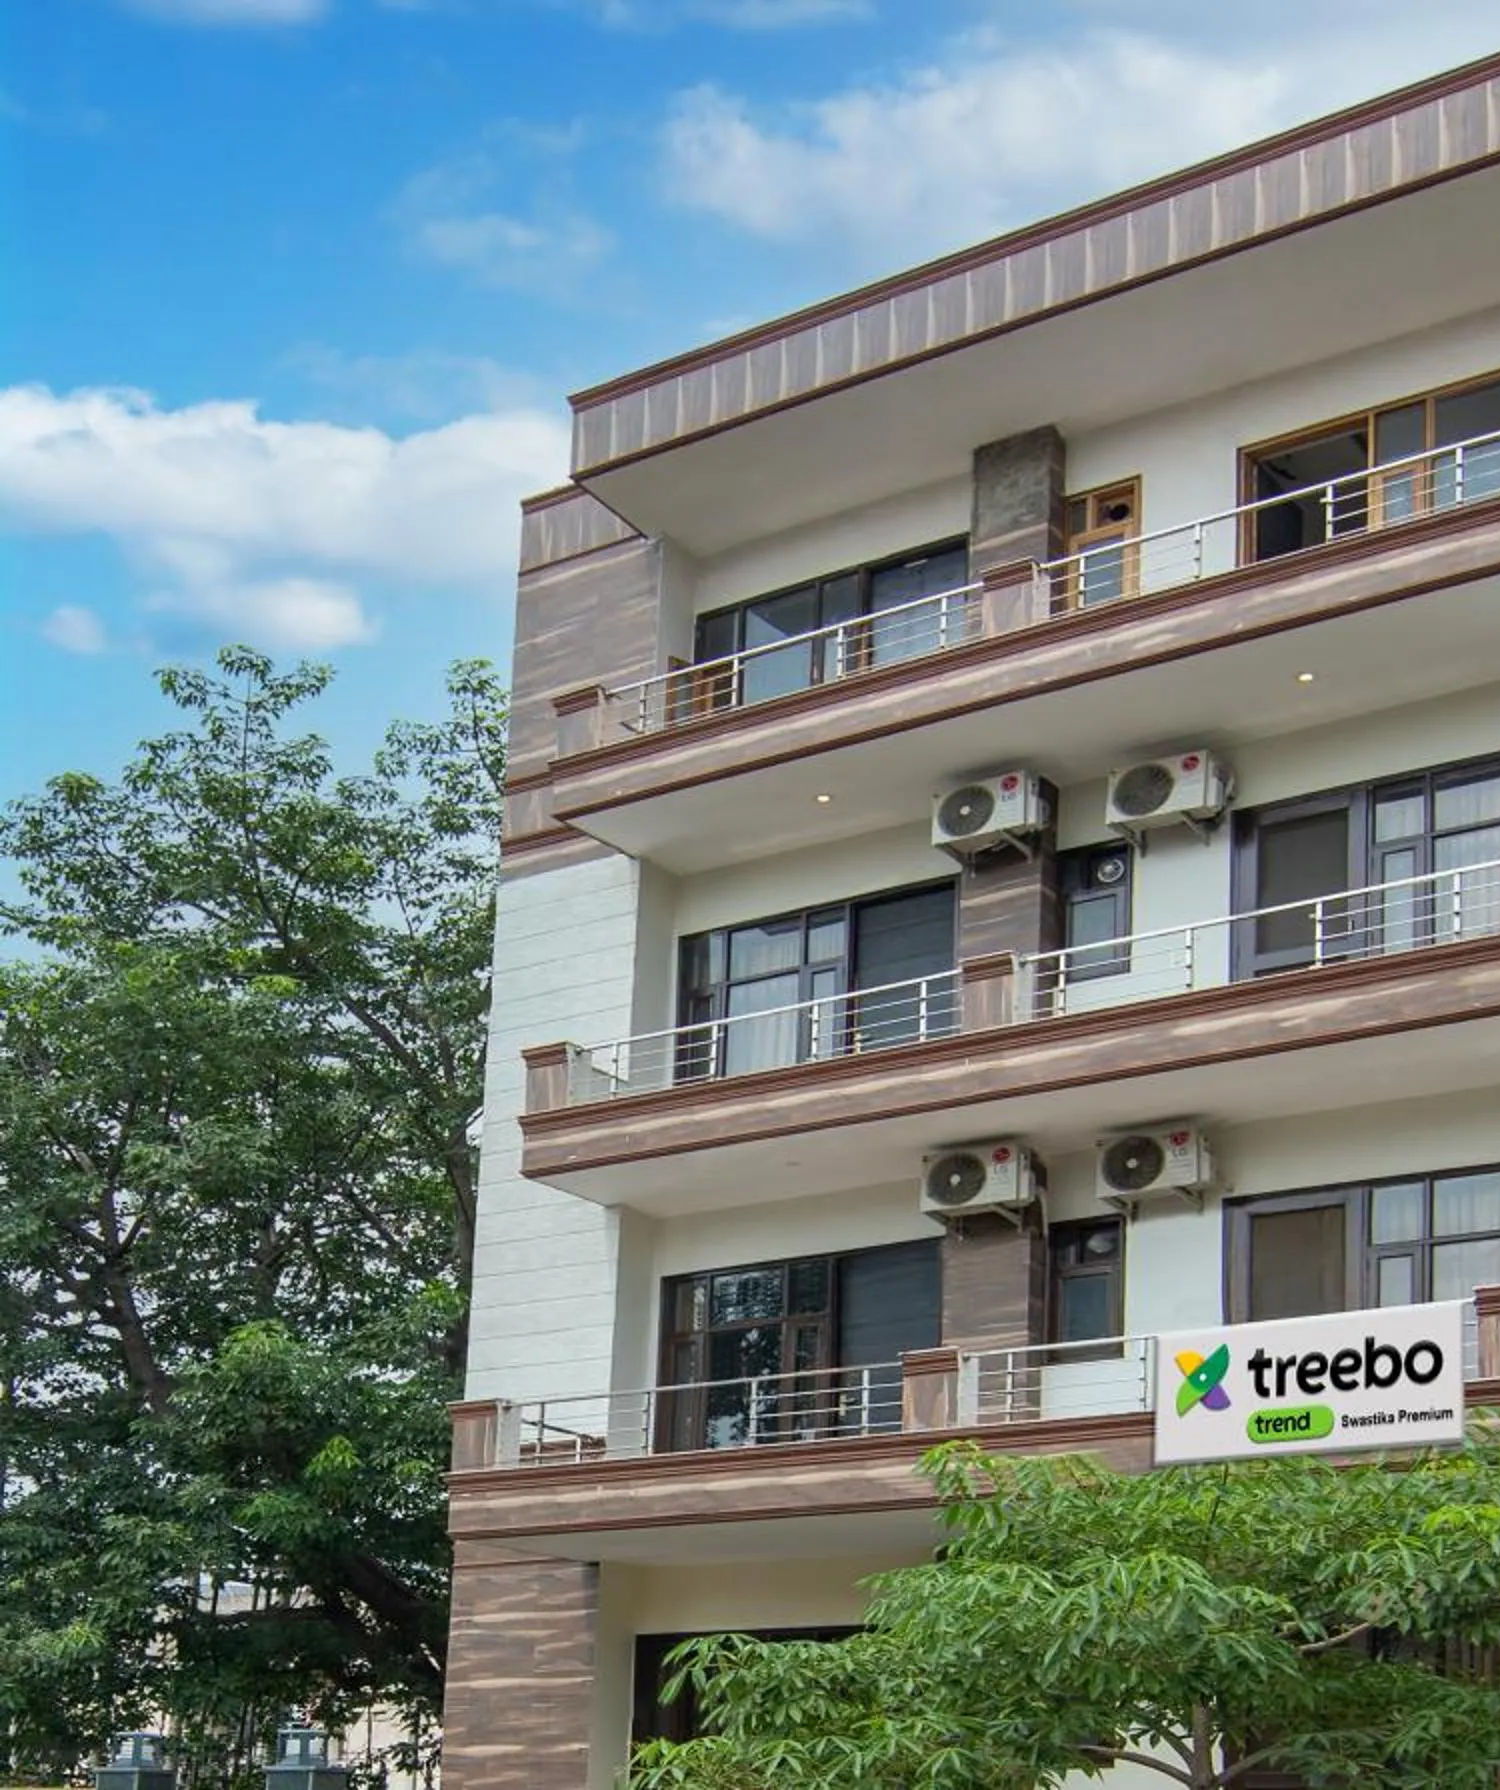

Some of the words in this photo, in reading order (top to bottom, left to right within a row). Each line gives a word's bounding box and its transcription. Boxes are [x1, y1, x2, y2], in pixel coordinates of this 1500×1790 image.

[1248, 1336, 1443, 1398] treebo
[1255, 1412, 1311, 1434] trend
[1341, 1411, 1395, 1428] Swastika
[1397, 1408, 1454, 1423] Premium
